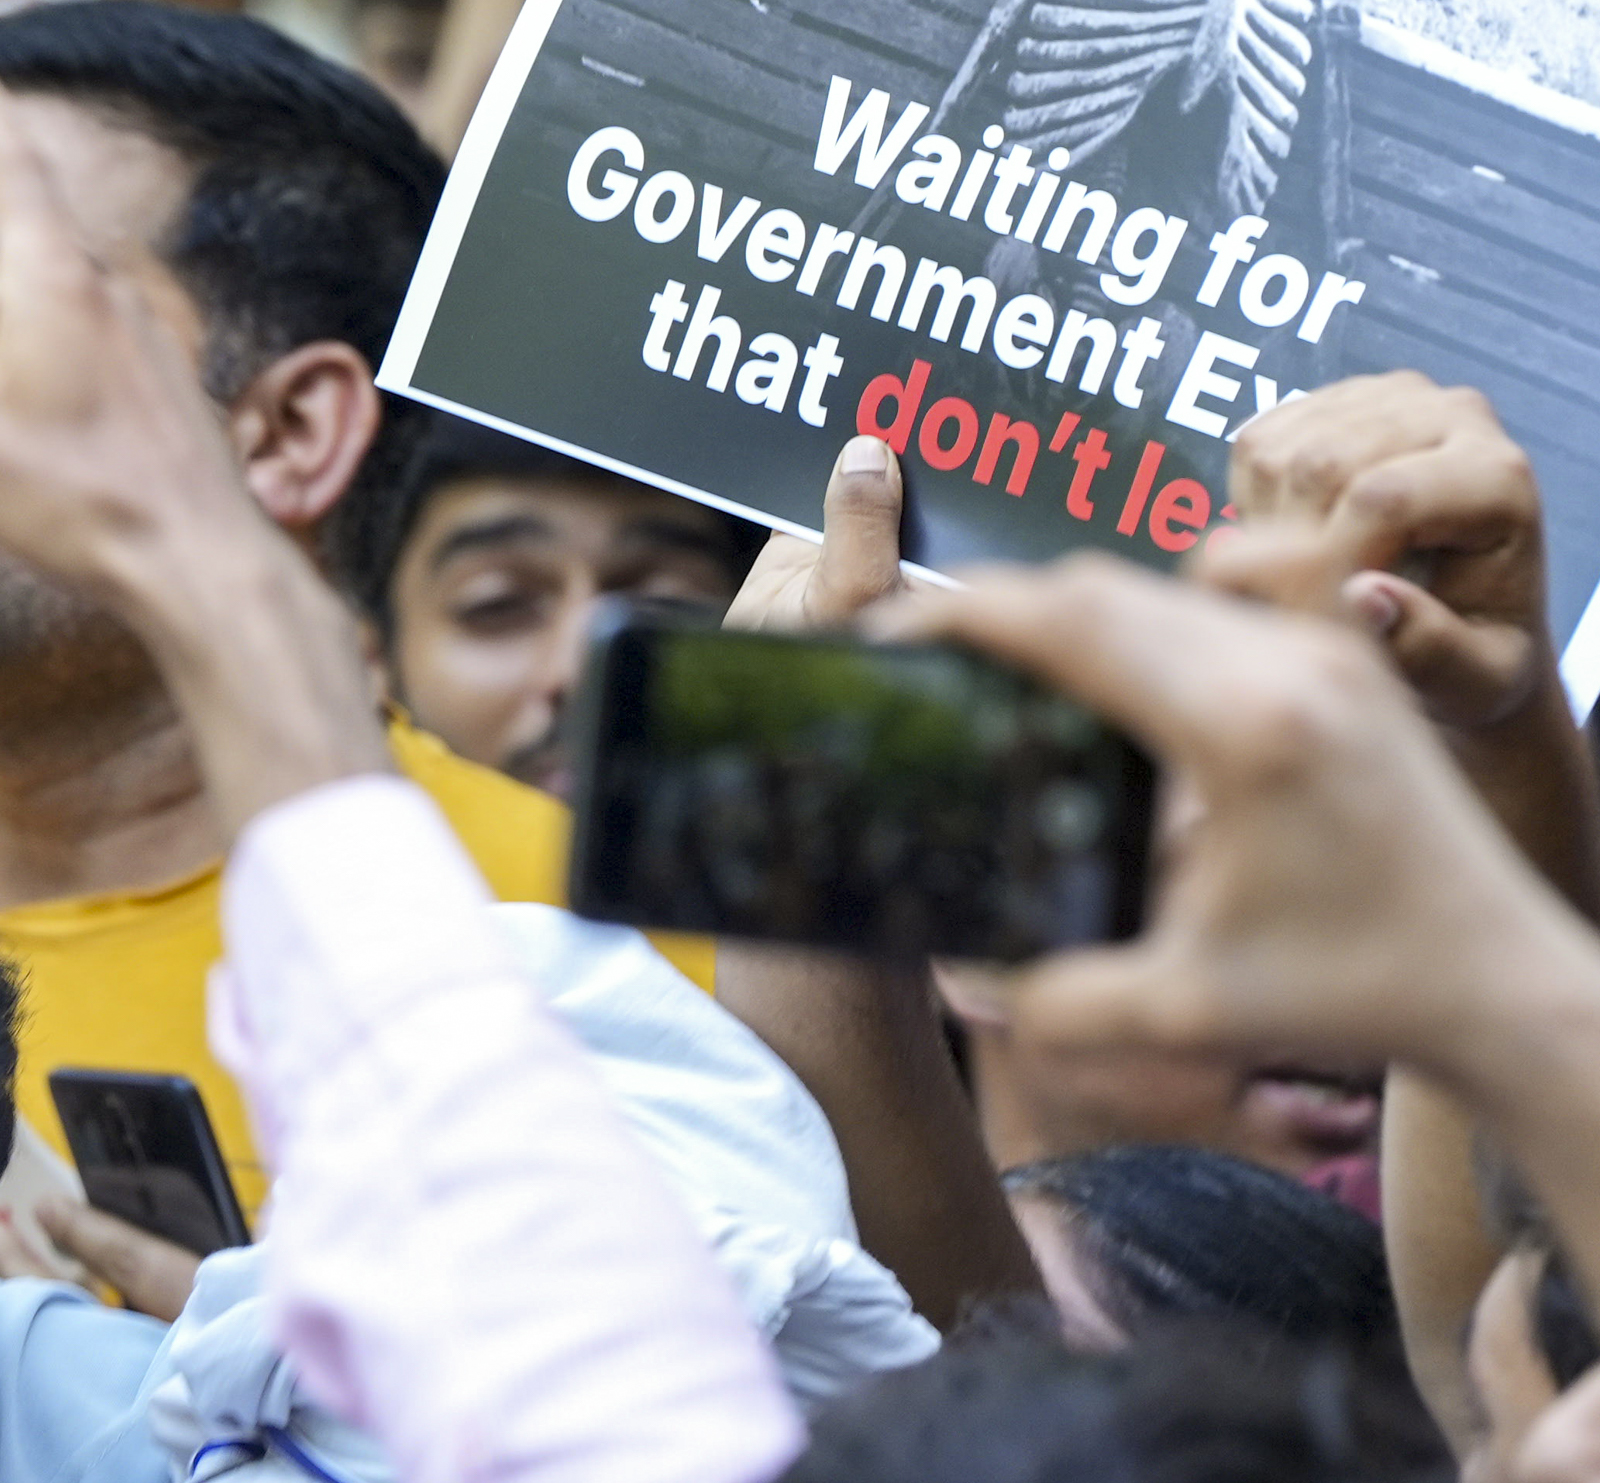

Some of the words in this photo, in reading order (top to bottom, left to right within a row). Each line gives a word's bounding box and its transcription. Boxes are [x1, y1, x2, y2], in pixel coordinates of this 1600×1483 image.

[567, 126, 1166, 409] Government
[813, 74, 1189, 306] Waiting
[1196, 214, 1366, 344] for
[642, 279, 844, 427] that
[856, 359, 1112, 521] don't
